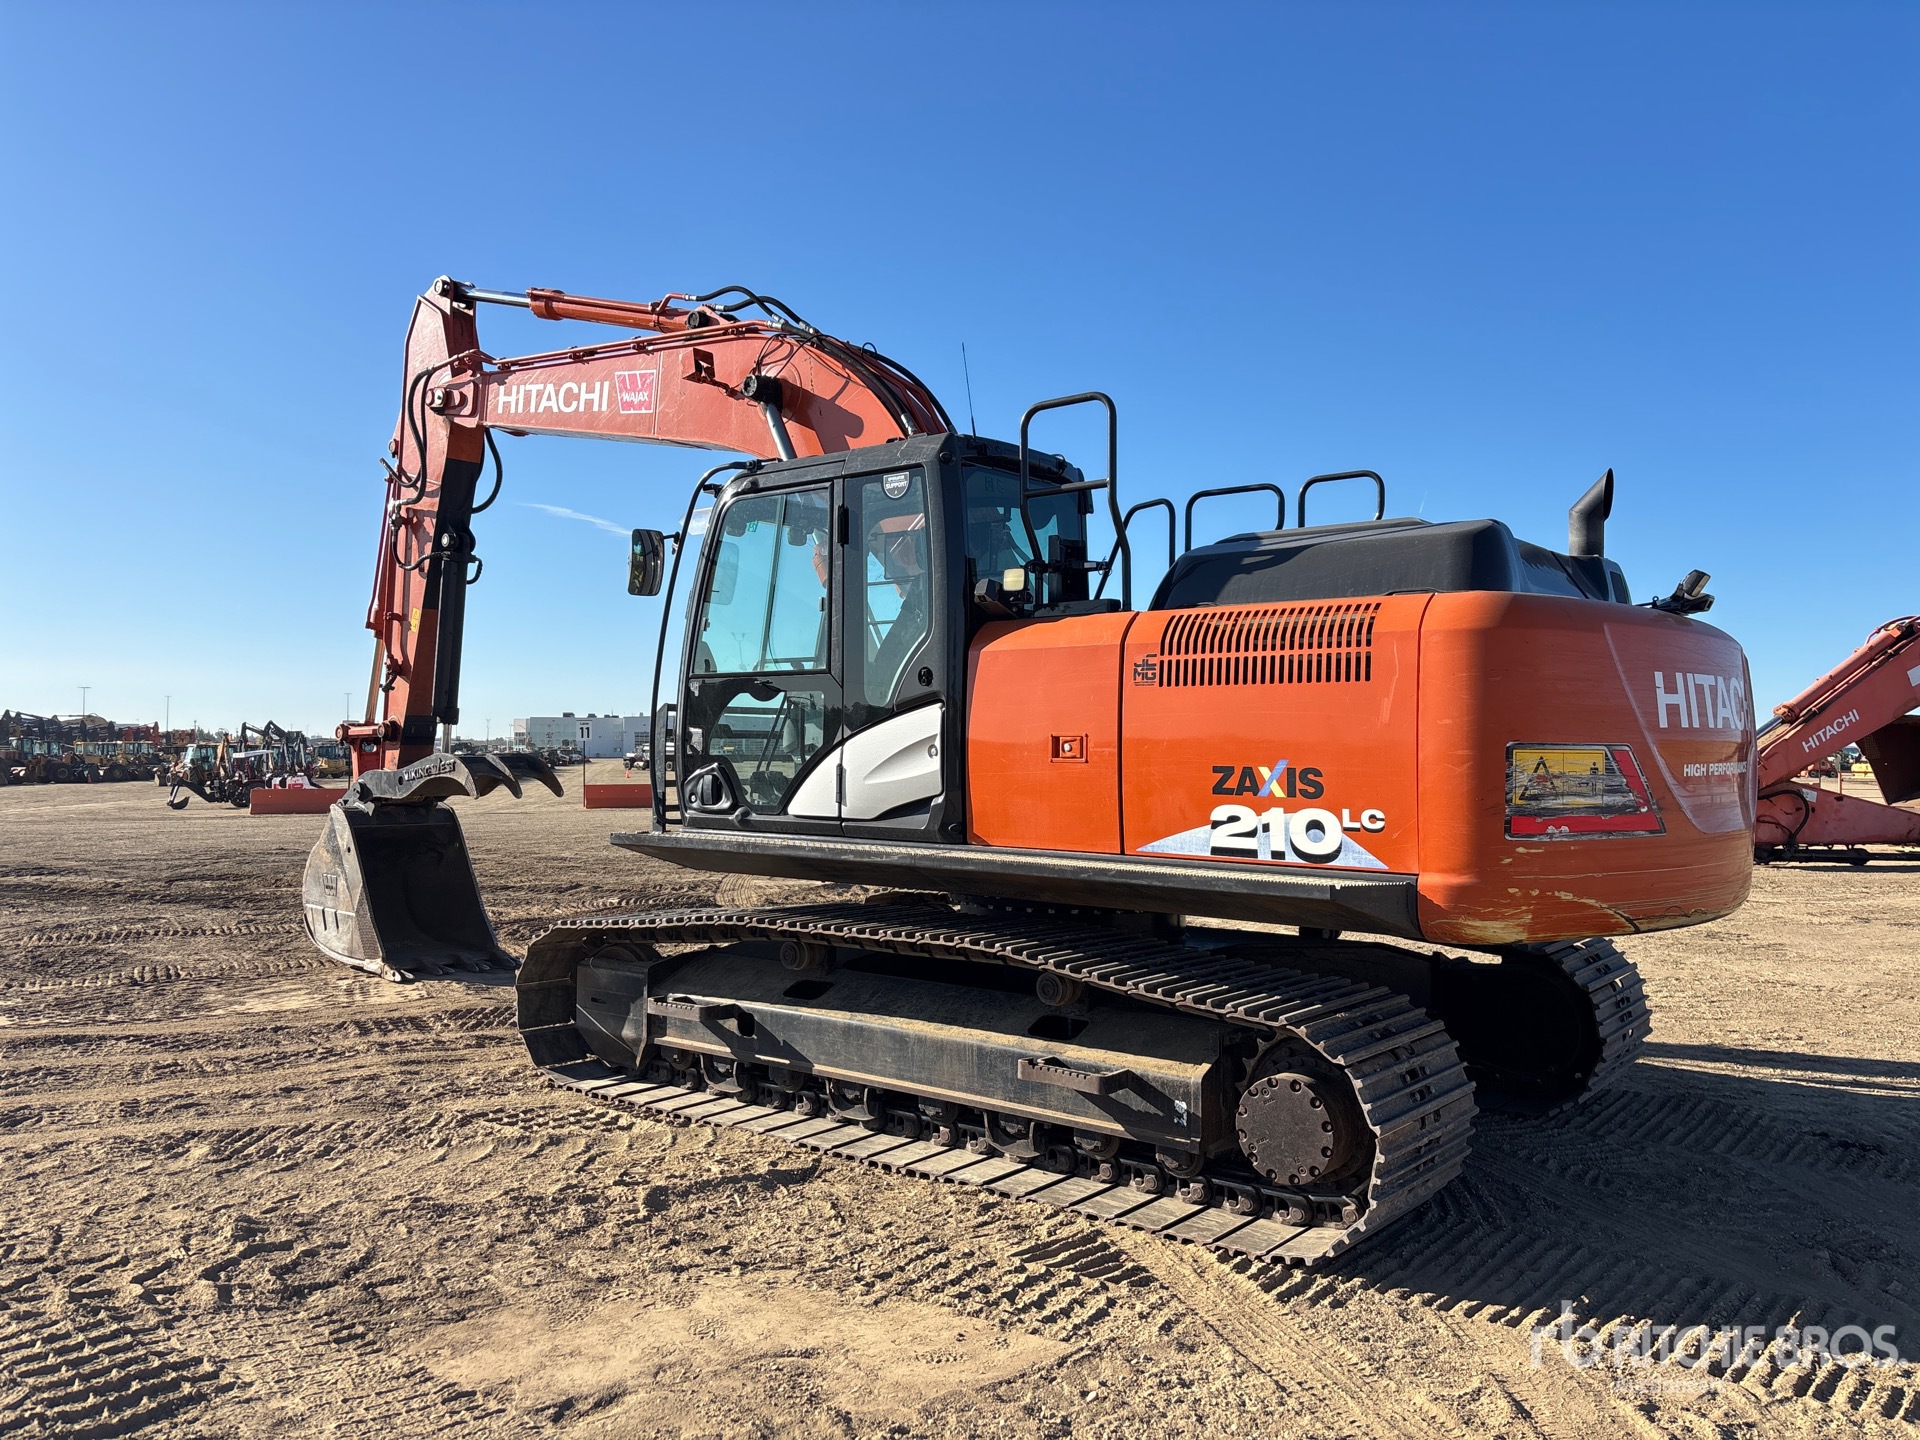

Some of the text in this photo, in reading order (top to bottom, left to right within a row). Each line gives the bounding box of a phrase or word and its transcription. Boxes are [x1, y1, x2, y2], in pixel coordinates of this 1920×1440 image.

[497, 381, 610, 414] HITACHI
[622, 391, 649, 405] WAJAX
[1654, 671, 1752, 732] HITACH
[579, 726, 590, 739] 11
[1801, 708, 1860, 753] HITACHI
[1211, 759, 1325, 800] ZAXIS
[1683, 763, 1707, 777] HIGH
[1209, 803, 1343, 864] 210
